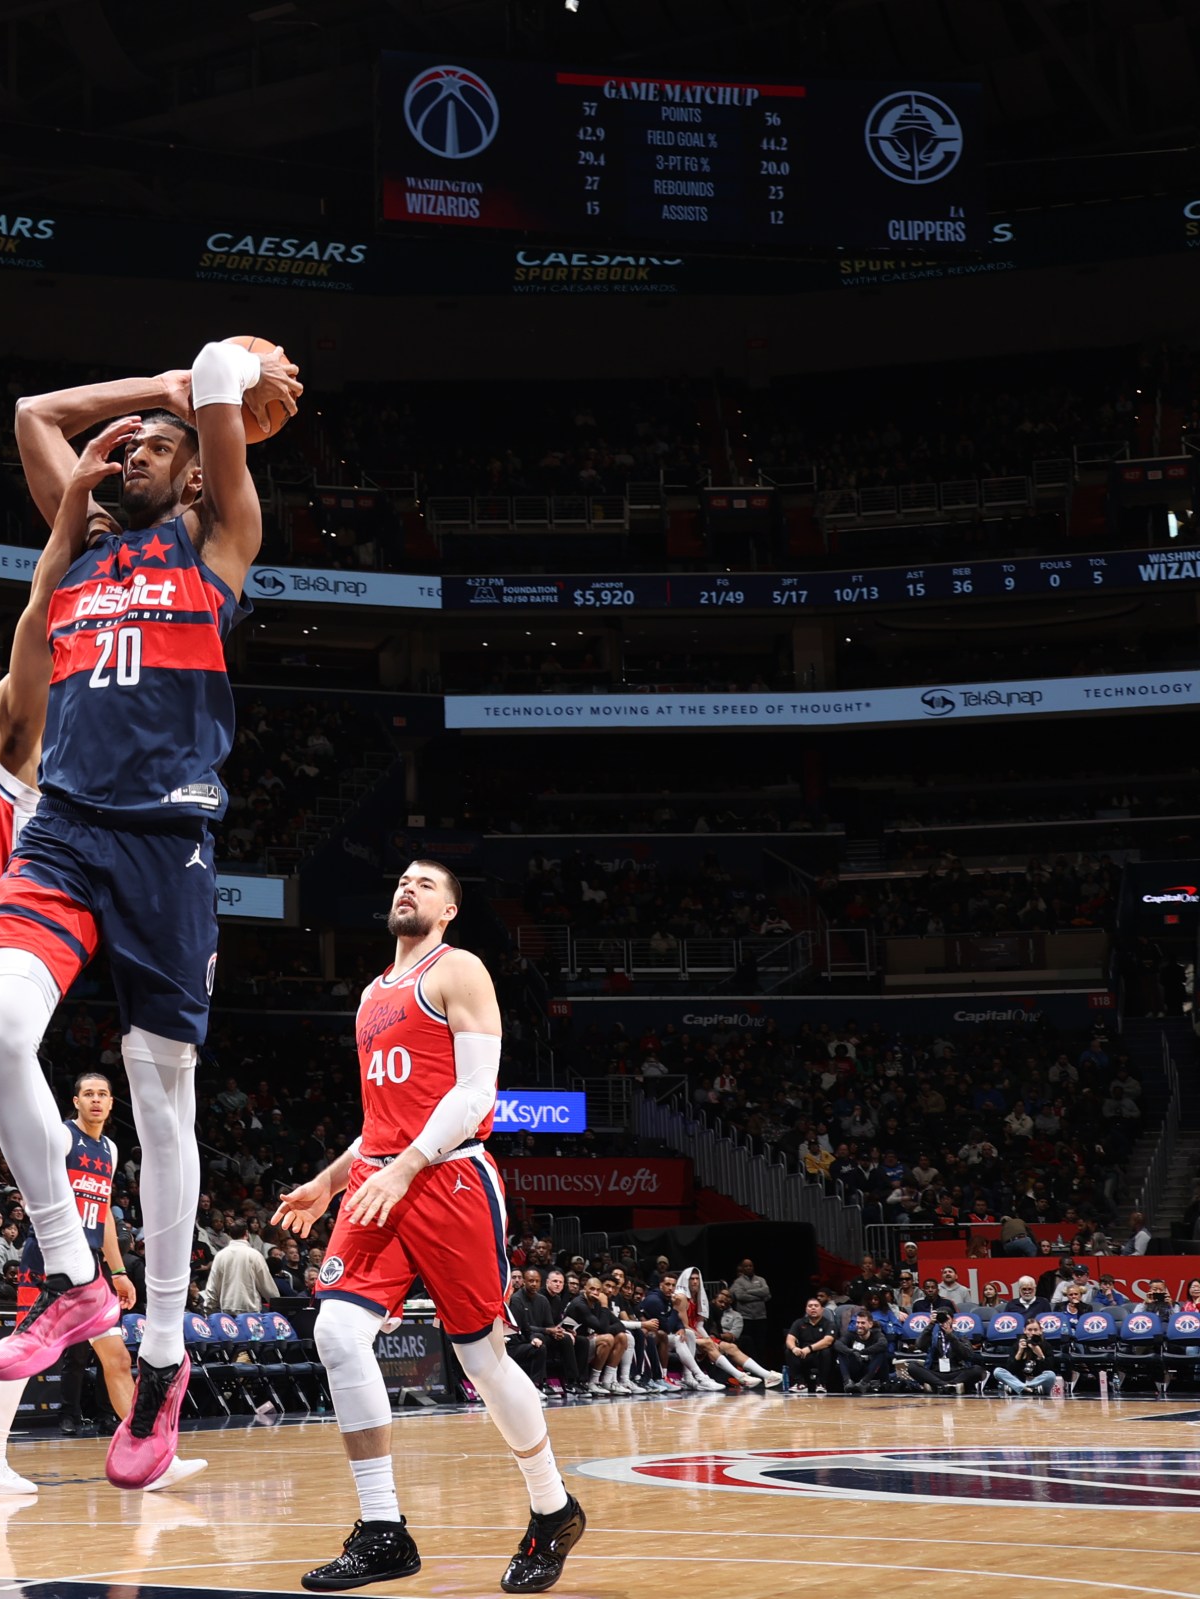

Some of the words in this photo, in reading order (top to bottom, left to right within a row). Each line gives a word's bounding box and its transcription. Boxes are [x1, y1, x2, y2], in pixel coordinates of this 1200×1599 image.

[603, 79, 661, 102] GAME
[662, 82, 760, 107] MATCHUP
[582, 101, 598, 117] 57
[661, 106, 702, 123] POINTS
[764, 112, 781, 127] 56
[576, 126, 606, 142] 42.9
[647, 130, 675, 147] FIELD
[676, 132, 706, 148] GOAL
[707, 133, 718, 149] %
[760, 136, 788, 152] 44.2
[577, 151, 606, 167] 29.4
[656, 155, 683, 171] 3-PT
[684, 157, 698, 172] FG
[699, 157, 711, 173] %
[760, 161, 789, 176] 20.0
[405, 176, 484, 195] WASHINGTON
[584, 176, 600, 191] 27
[653, 180, 715, 197] REBOUNDS
[405, 192, 480, 219] WIZARDS
[586, 201, 600, 216] 15
[661, 204, 708, 222] ASSISTS
[949, 206, 965, 218] LA
[769, 210, 784, 225] 12
[888, 219, 966, 243] CLIPPERS
[206, 232, 368, 264] CAESARS
[199, 253, 332, 277] SPORTSBOOK
[231, 273, 288, 286] CAESARS
[514, 266, 652, 281] SPORTSBOOK
[881, 268, 944, 283] CAESARS
[550, 284, 609, 293] CAESARS
[1002, 564, 1016, 573] TO
[1040, 560, 1072, 570] FOULS
[1089, 557, 1108, 568] TOL
[851, 575, 864, 584] FT
[906, 570, 925, 580] AST
[952, 567, 972, 577] REB
[1093, 571, 1104, 585] 5
[289, 575, 367, 597] TekSynap
[466, 578, 487, 587] 4:27
[488, 578, 505, 587] PM
[716, 578, 731, 587] FG
[781, 578, 799, 587] 3PT
[952, 580, 973, 594] 36
[1004, 577, 1015, 591] 9
[1049, 574, 1061, 588] 0
[105, 585, 124, 594] THE
[503, 586, 558, 594] FOUNDATION
[833, 587, 880, 602] 10/13
[906, 583, 926, 597] 15
[530, 595, 559, 603] RAFFLE
[573, 589, 635, 607] $5,920
[699, 590, 745, 605] 21/49
[772, 590, 808, 605] 5/17
[88, 627, 142, 689] 20
[959, 689, 1043, 707] TekSynap
[1083, 683, 1192, 698] TECHNOLOGY
[484, 706, 583, 717] TECHNOLOGY
[590, 705, 649, 716] MOVING
[656, 705, 673, 715] AT
[679, 705, 706, 715] THE
[713, 705, 758, 715] SPEED
[766, 704, 784, 715] OF
[1092, 995, 1111, 1006] 118
[365, 1001, 390, 1028] Los
[552, 1004, 568, 1015] 118
[366, 1046, 412, 1087] 40
[506, 1167, 607, 1197] Hennessy
[608, 1167, 660, 1196] Lofts
[82, 1201, 99, 1230] 18
[376, 1335, 426, 1358] AESARS
